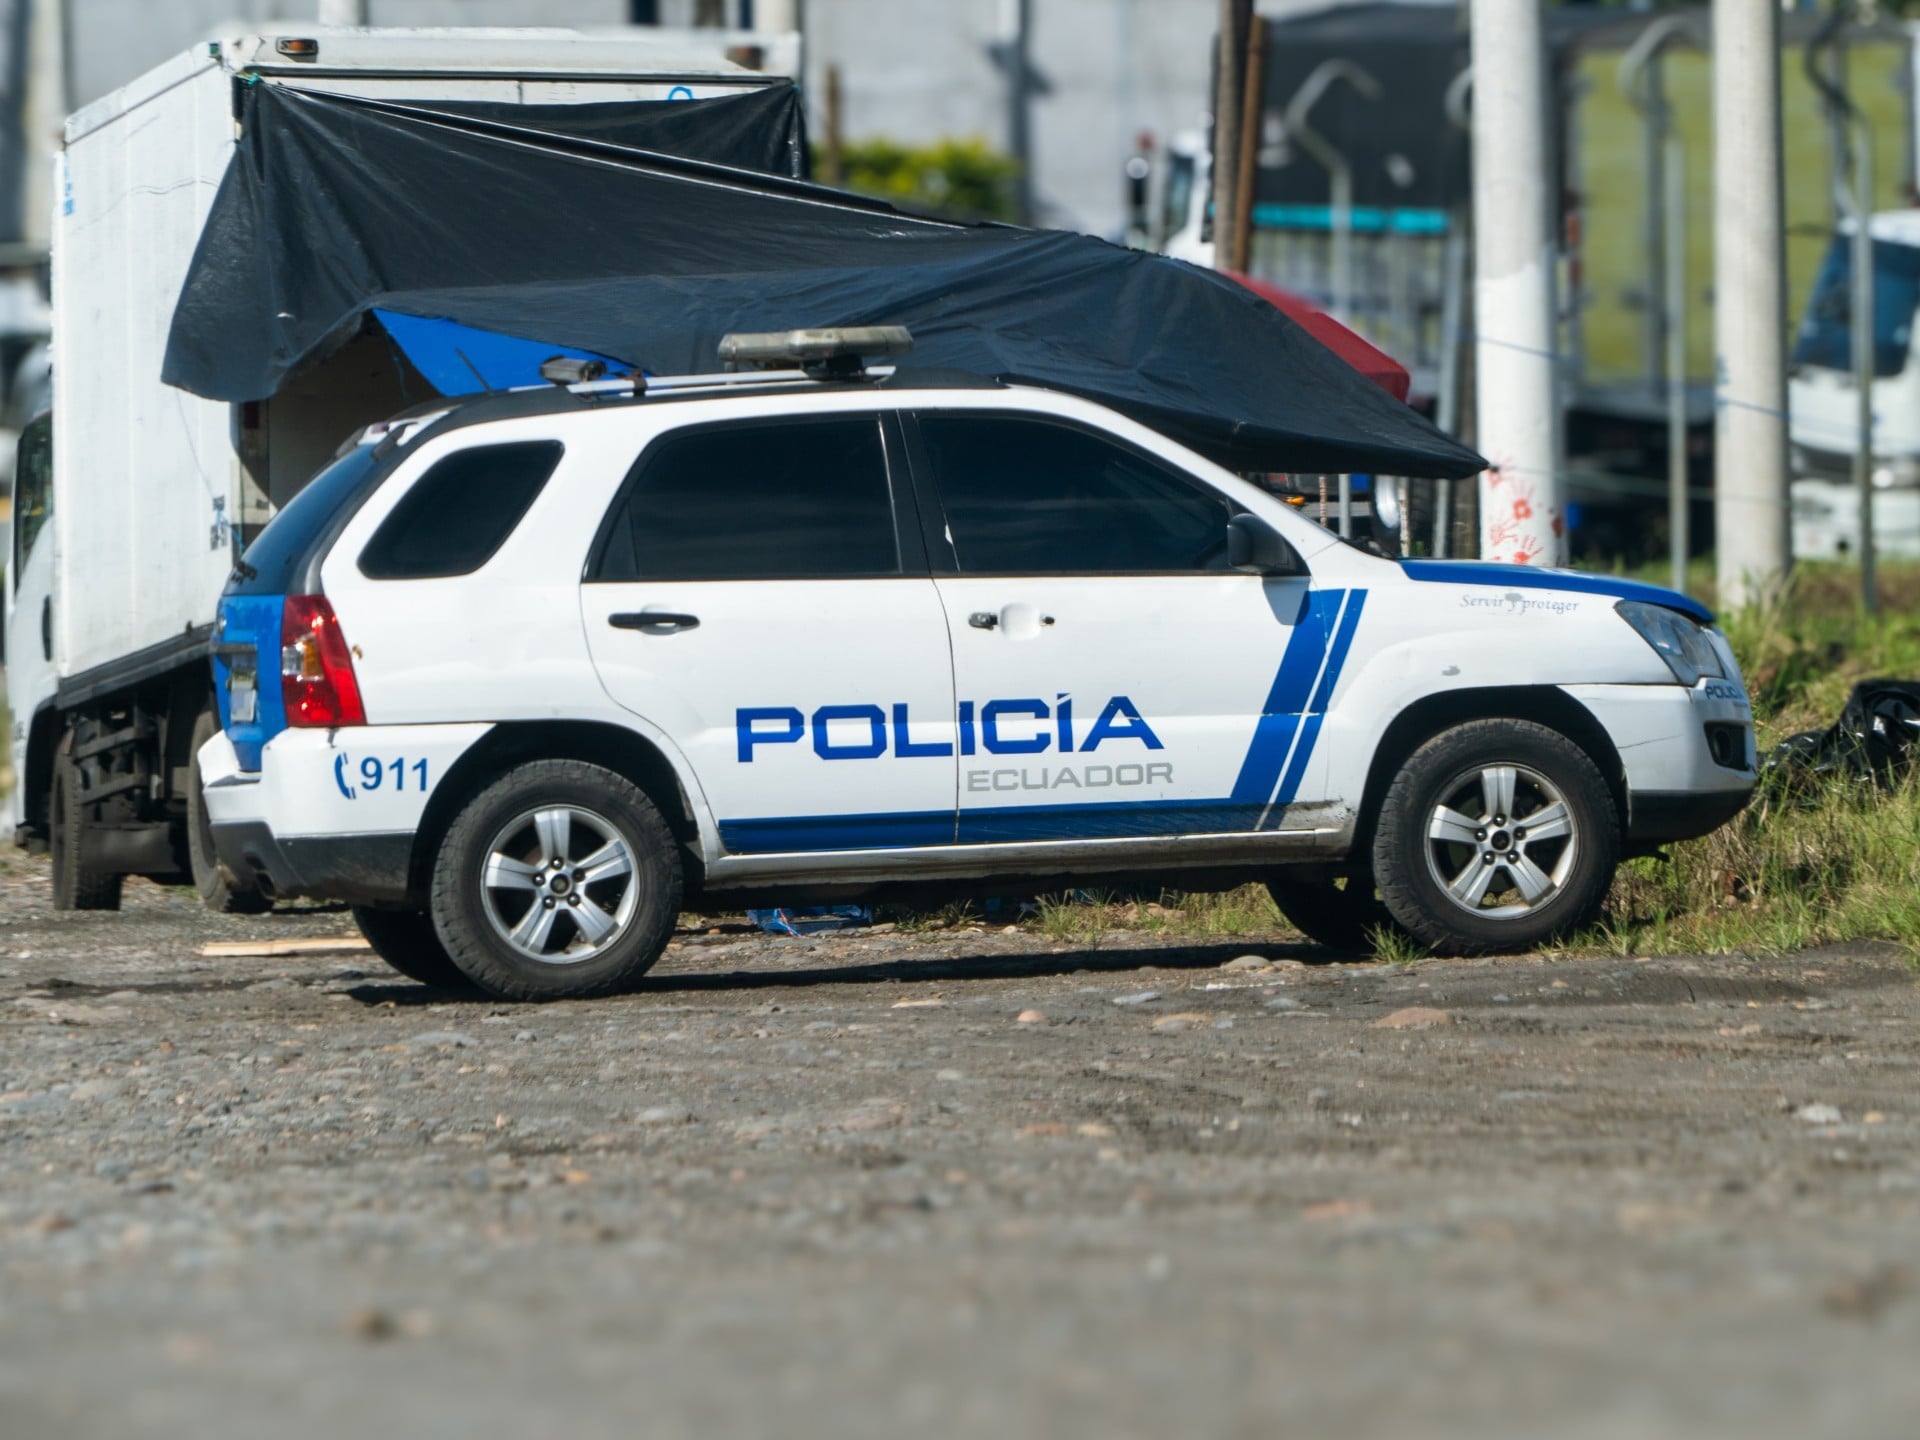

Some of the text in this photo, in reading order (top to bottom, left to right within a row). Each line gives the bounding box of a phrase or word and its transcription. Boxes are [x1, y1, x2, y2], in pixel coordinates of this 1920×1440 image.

[1460, 594, 1504, 608] Servir
[1520, 599, 1579, 615] proteger
[736, 693, 1165, 763] POLICÍA
[361, 757, 428, 792] 911
[967, 762, 1173, 792] ECUADOR
